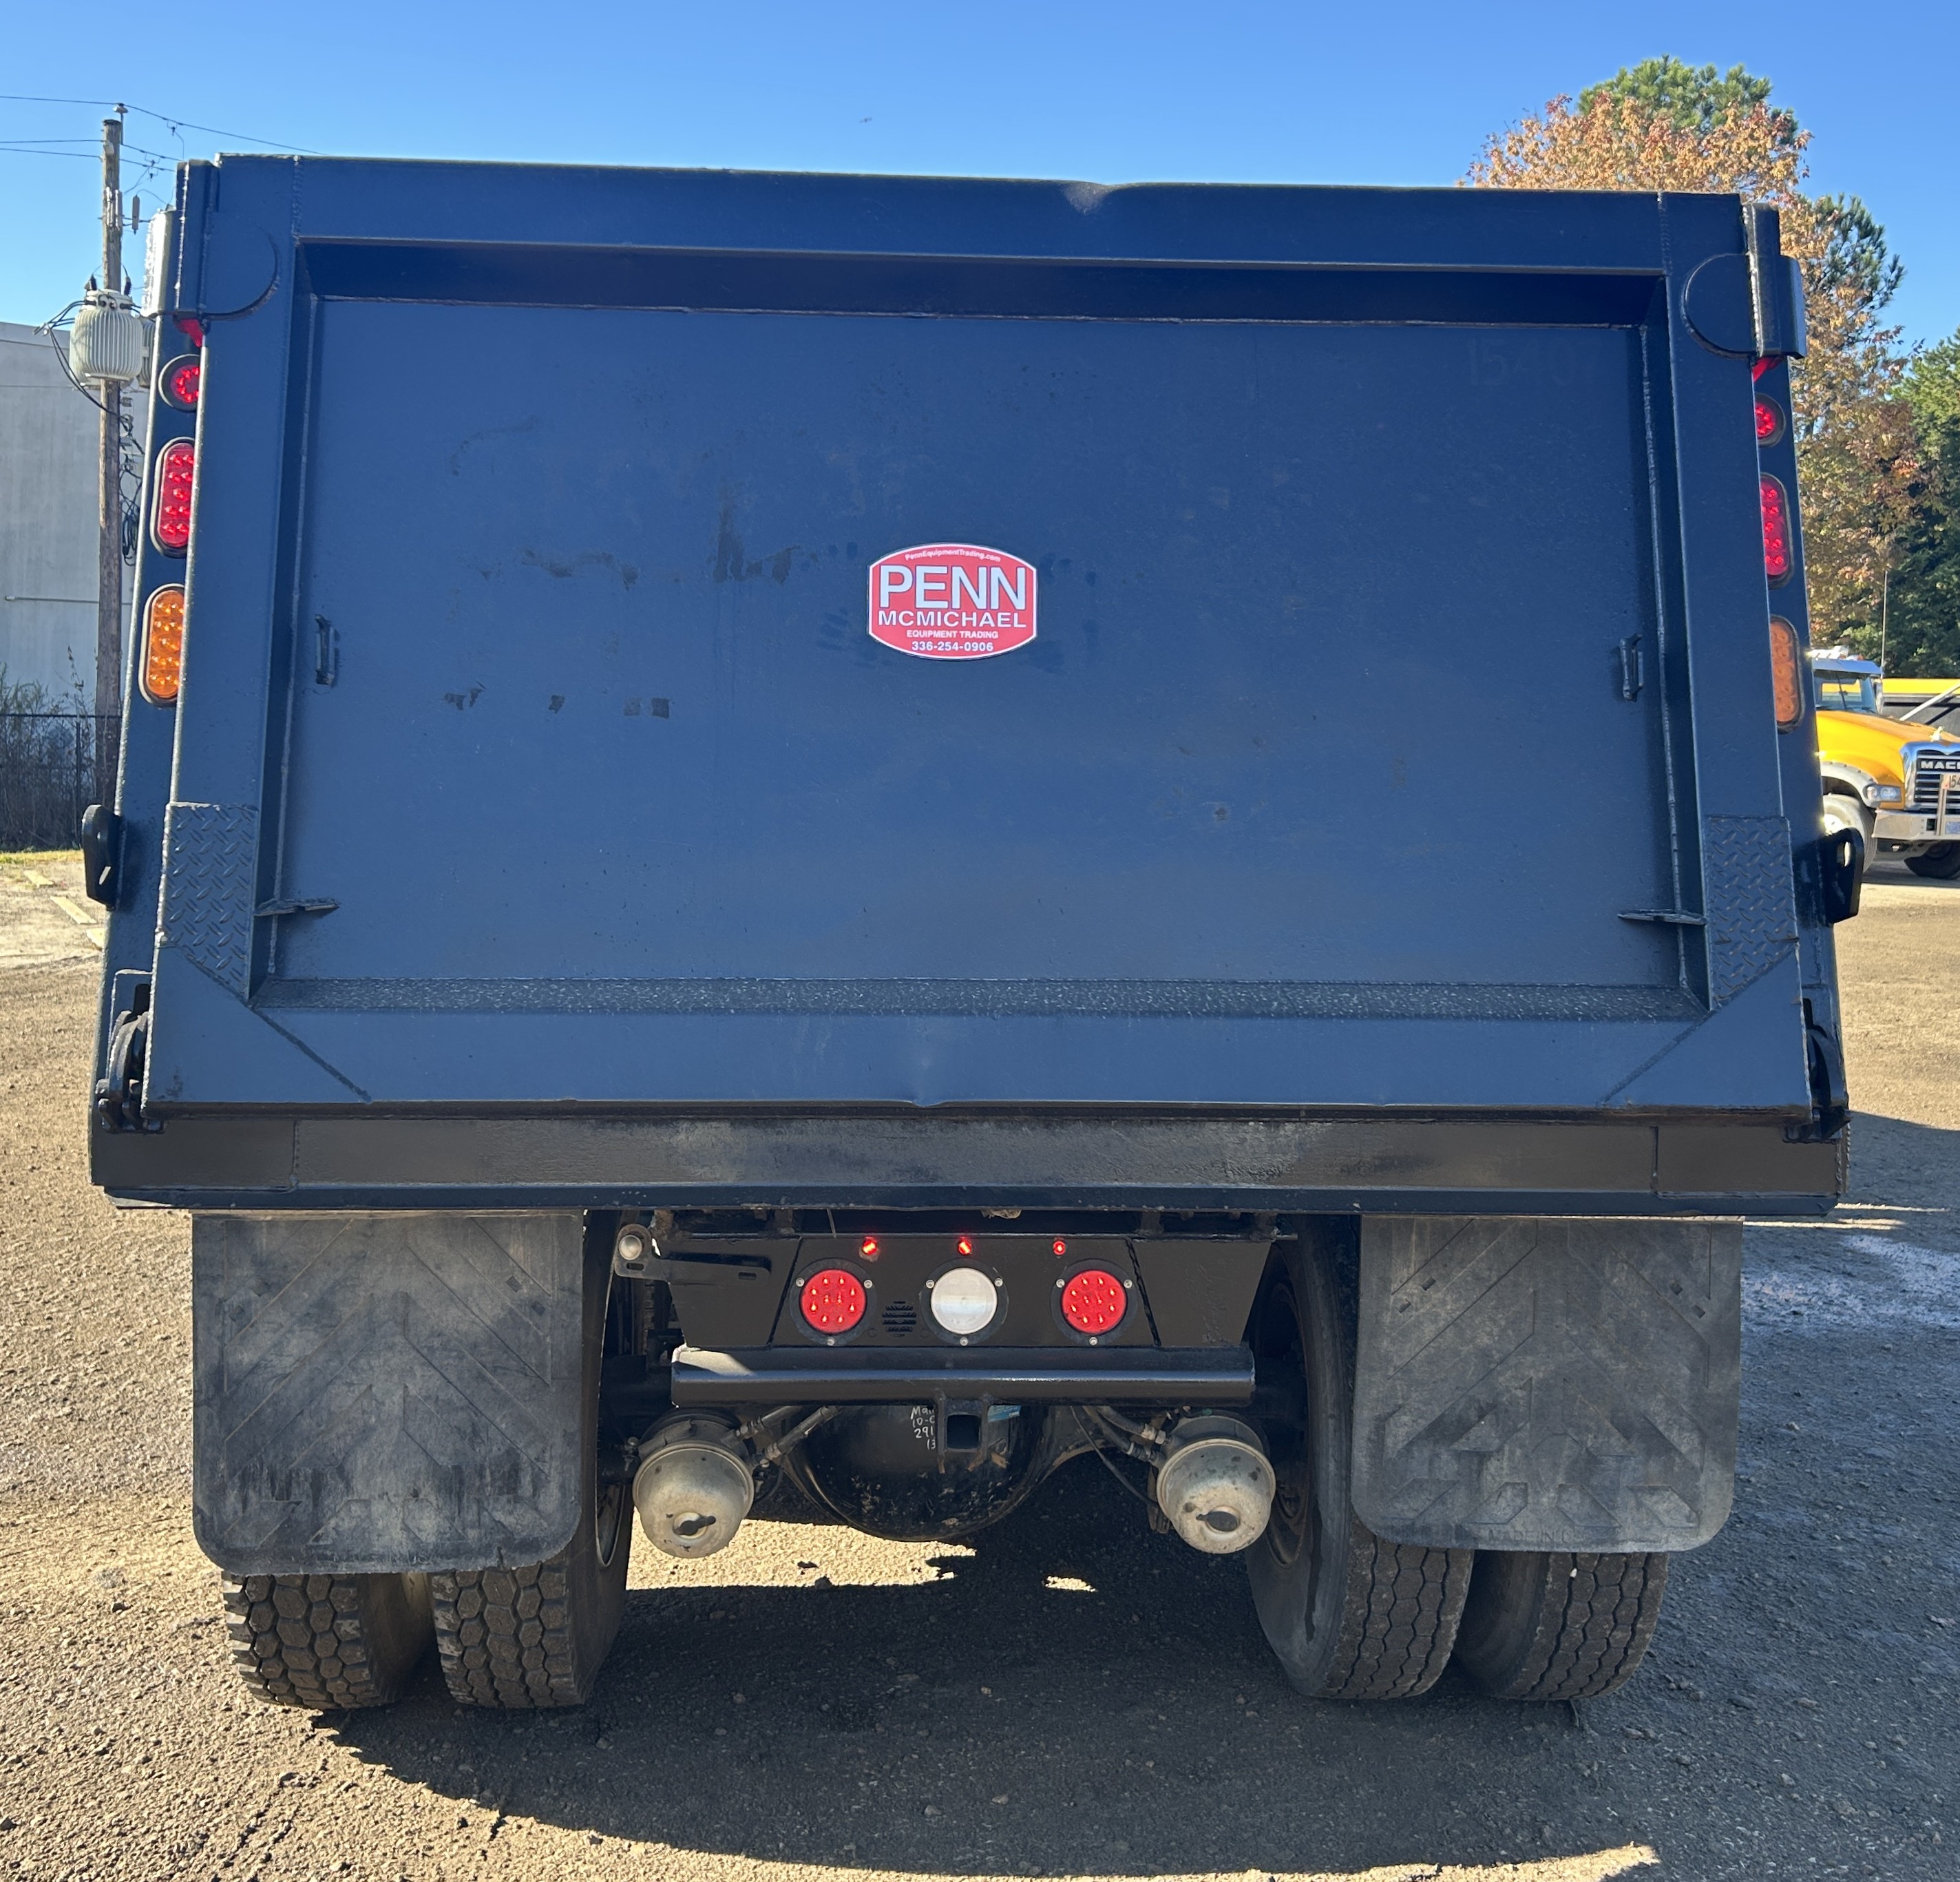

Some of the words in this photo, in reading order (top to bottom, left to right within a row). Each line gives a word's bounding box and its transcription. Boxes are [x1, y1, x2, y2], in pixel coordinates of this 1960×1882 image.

[905, 549, 1001, 563] PennEquipmentTrading.com
[879, 565, 1026, 610] PENN
[878, 610, 1027, 628] MCMICHAEL
[907, 630, 956, 639] EQUIPMENT
[959, 631, 998, 639] TRADING
[911, 640, 993, 651] 336-254-0906
